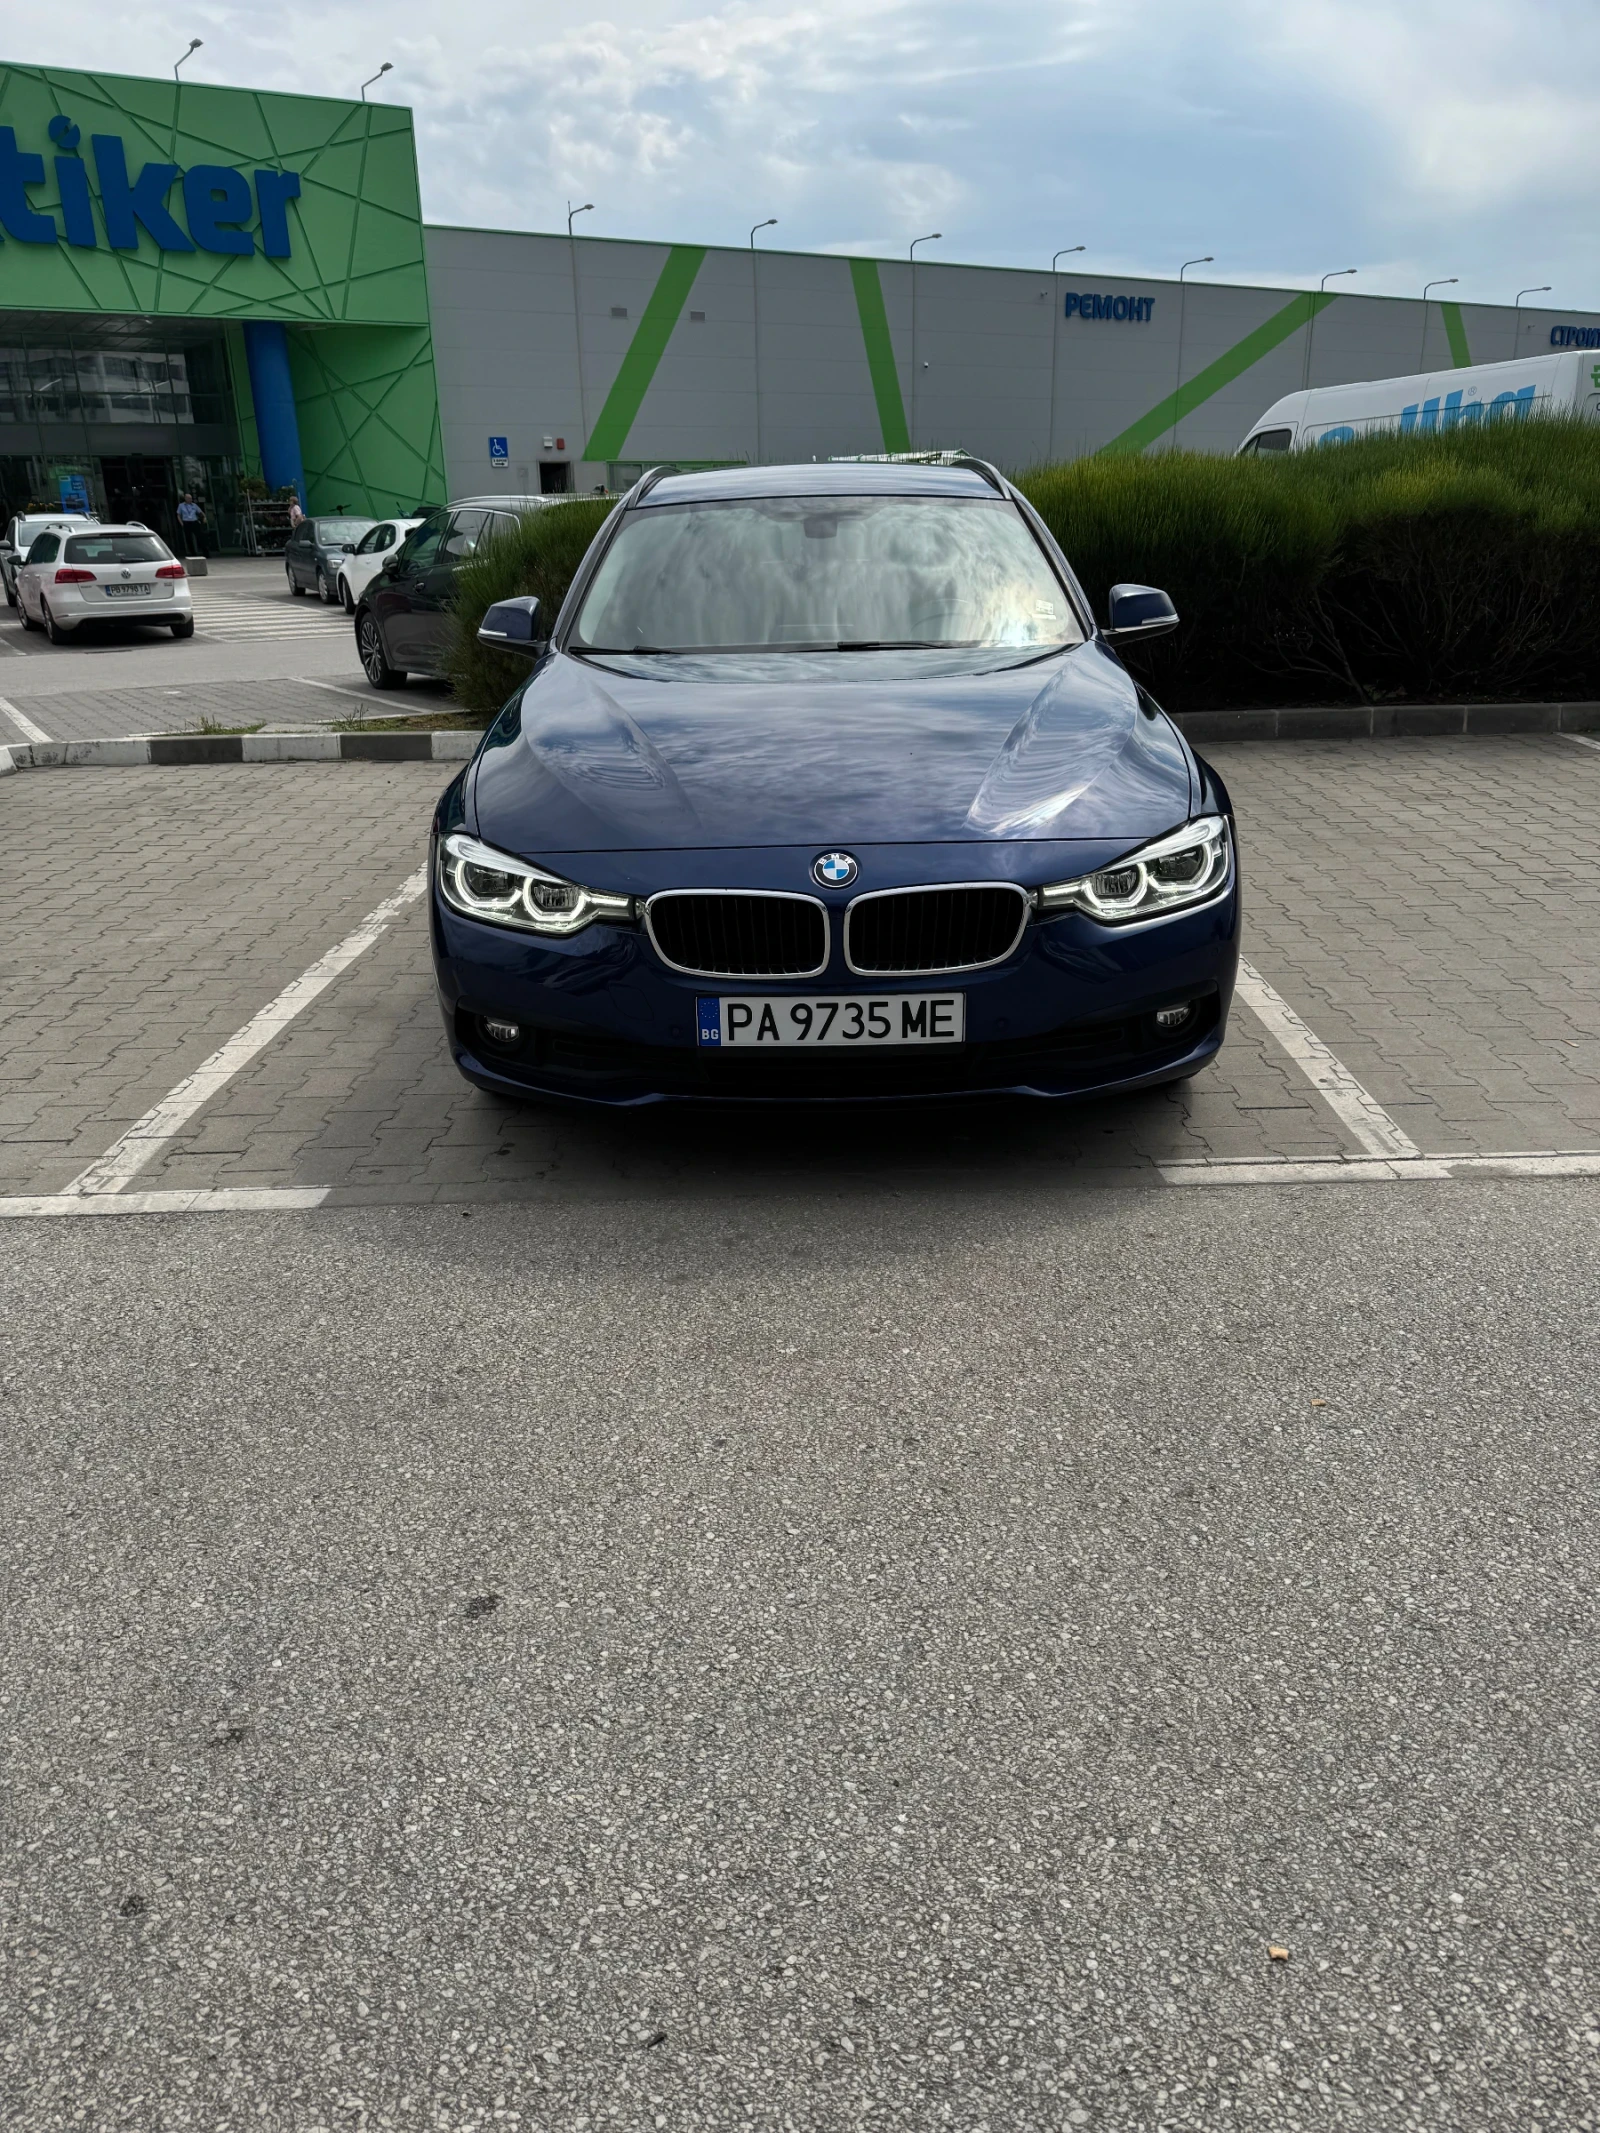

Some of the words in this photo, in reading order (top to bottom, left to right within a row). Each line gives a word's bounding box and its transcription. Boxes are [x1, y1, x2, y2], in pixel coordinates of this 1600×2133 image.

[1065, 292, 1155, 322] РЕМОНТ
[701, 1028, 719, 1040] BG
[727, 1003, 780, 1041] PA
[790, 1001, 892, 1041] 9735
[902, 999, 955, 1039] ME
